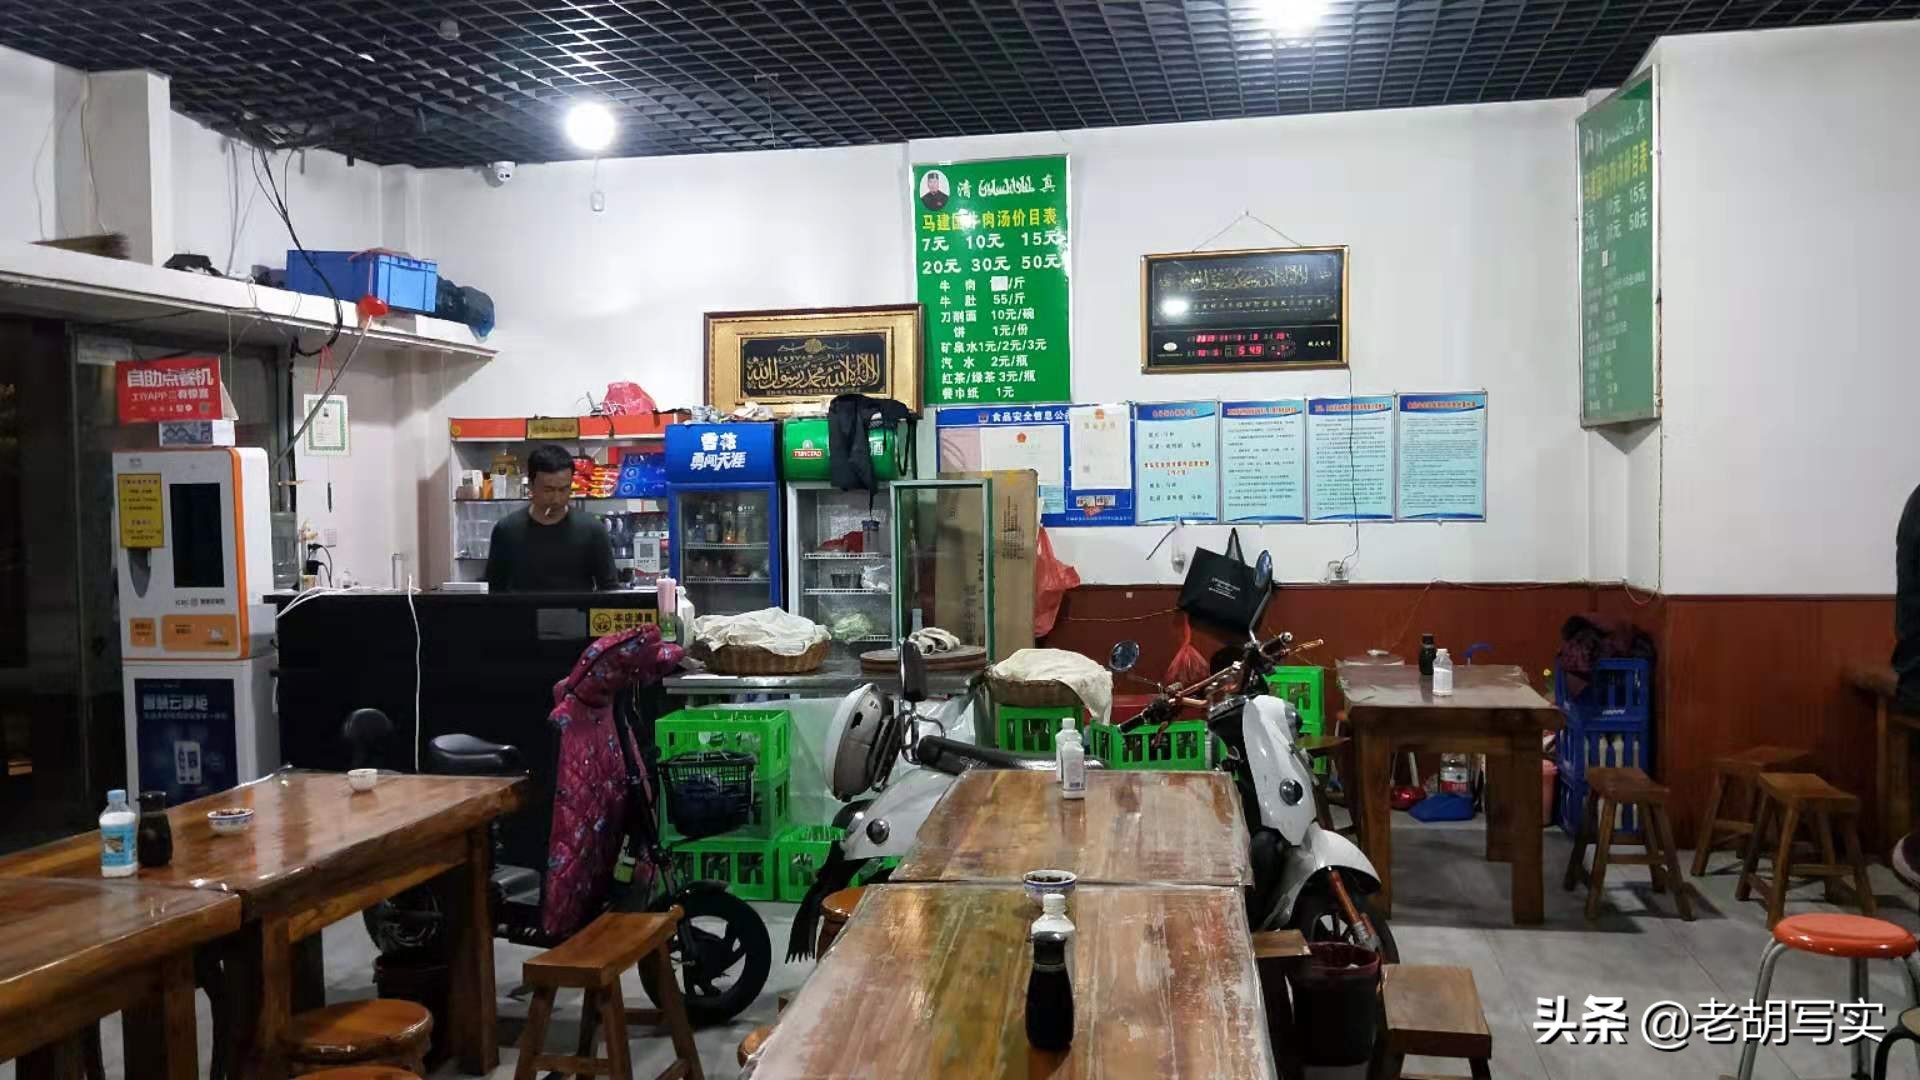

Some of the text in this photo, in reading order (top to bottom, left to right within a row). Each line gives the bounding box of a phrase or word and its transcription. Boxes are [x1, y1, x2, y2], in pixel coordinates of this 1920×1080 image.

[957, 178, 972, 199] 清
[1039, 173, 1056, 193] 真
[1629, 180, 1647, 202] 15元
[1629, 206, 1648, 231] 50元
[922, 230, 1061, 251] 7元 10元 15元
[922, 253, 1062, 275] 20元 30元 50元
[993, 292, 1025, 306] 55/斤
[941, 307, 1035, 323] 刀削面 10元/碗
[953, 323, 1028, 338] 饼 1元/份
[991, 354, 1028, 367] 2元/瓶
[127, 368, 214, 388] 自助点餐机
[941, 369, 1036, 384] 红茶/绿茶 3元/瓶
[942, 386, 1015, 400] 餐巾纸 1元
[700, 431, 737, 452] 雪花
[690, 451, 747, 471] 勇闯天涯
